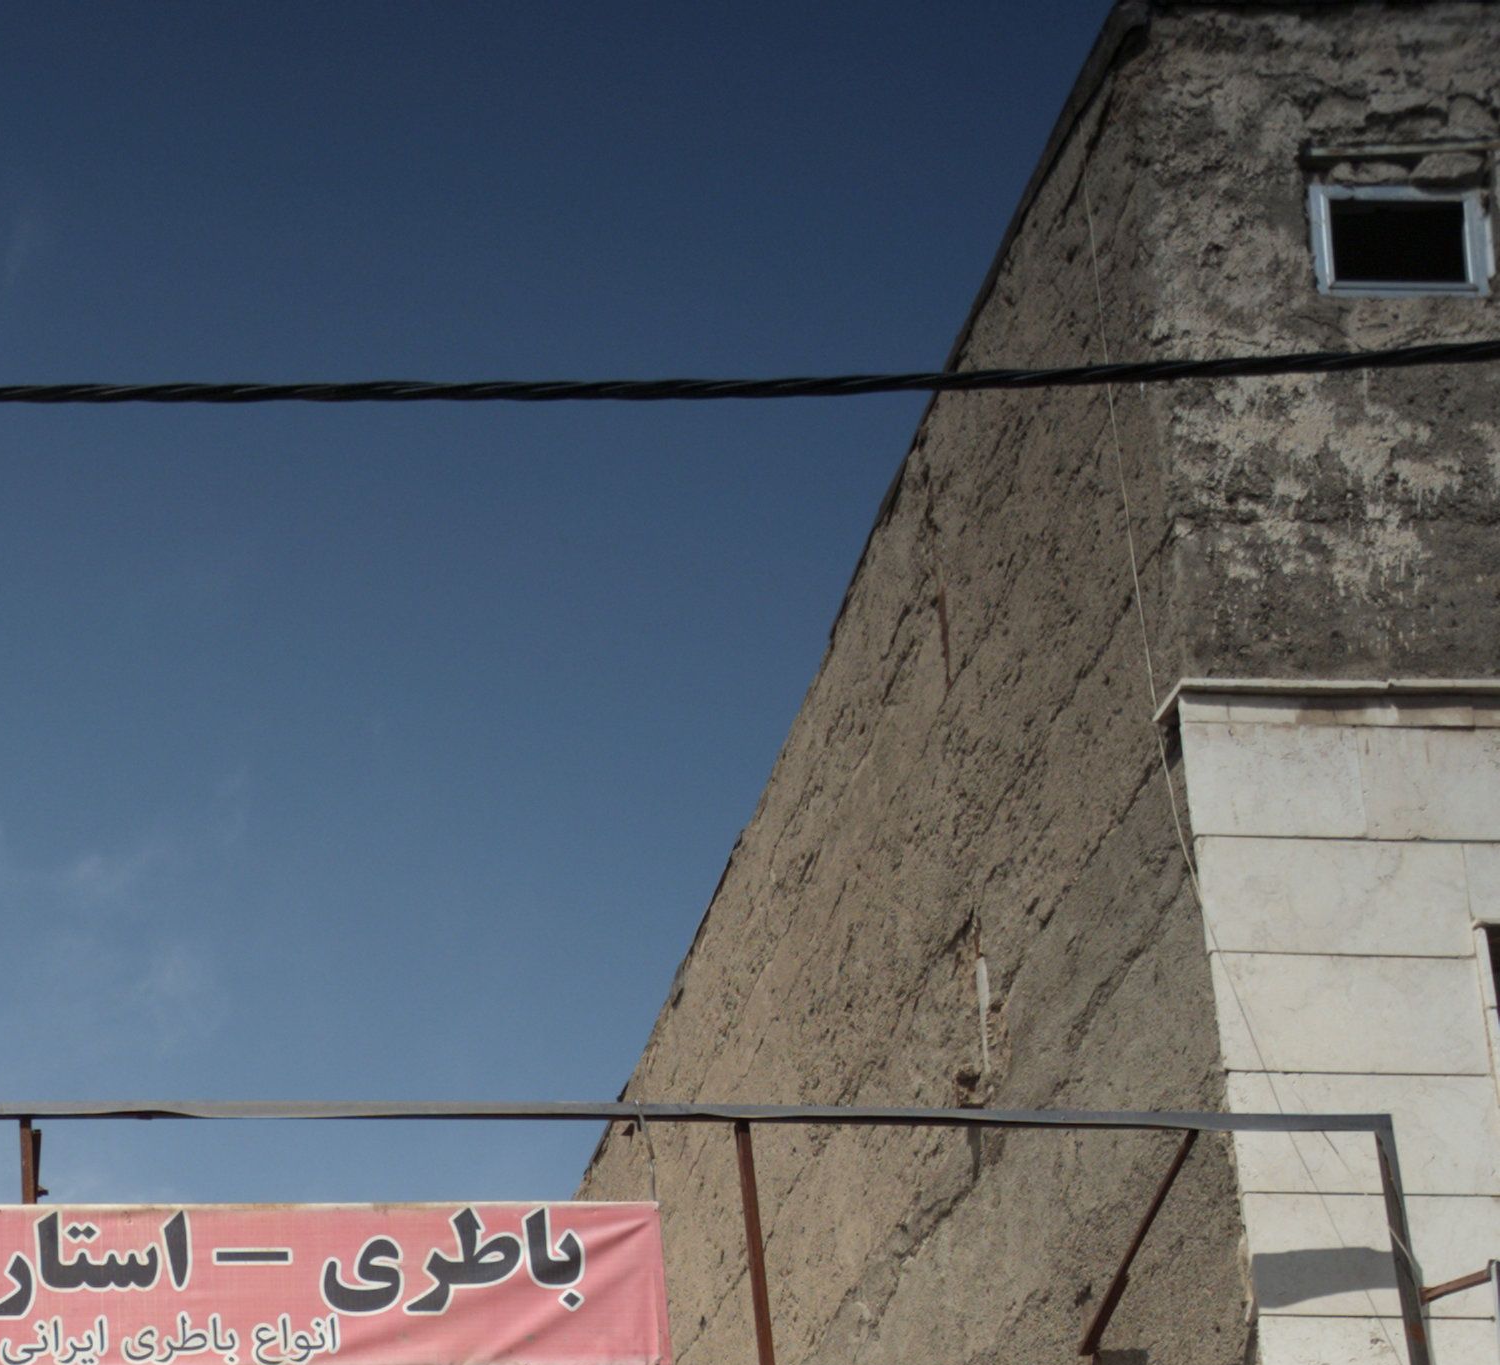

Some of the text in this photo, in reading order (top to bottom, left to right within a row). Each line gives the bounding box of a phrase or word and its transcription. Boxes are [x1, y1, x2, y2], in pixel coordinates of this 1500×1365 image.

[323, 1207, 583, 1313] باطری
[124, 1316, 237, 1365] باطری
[252, 1315, 338, 1365] انواع
